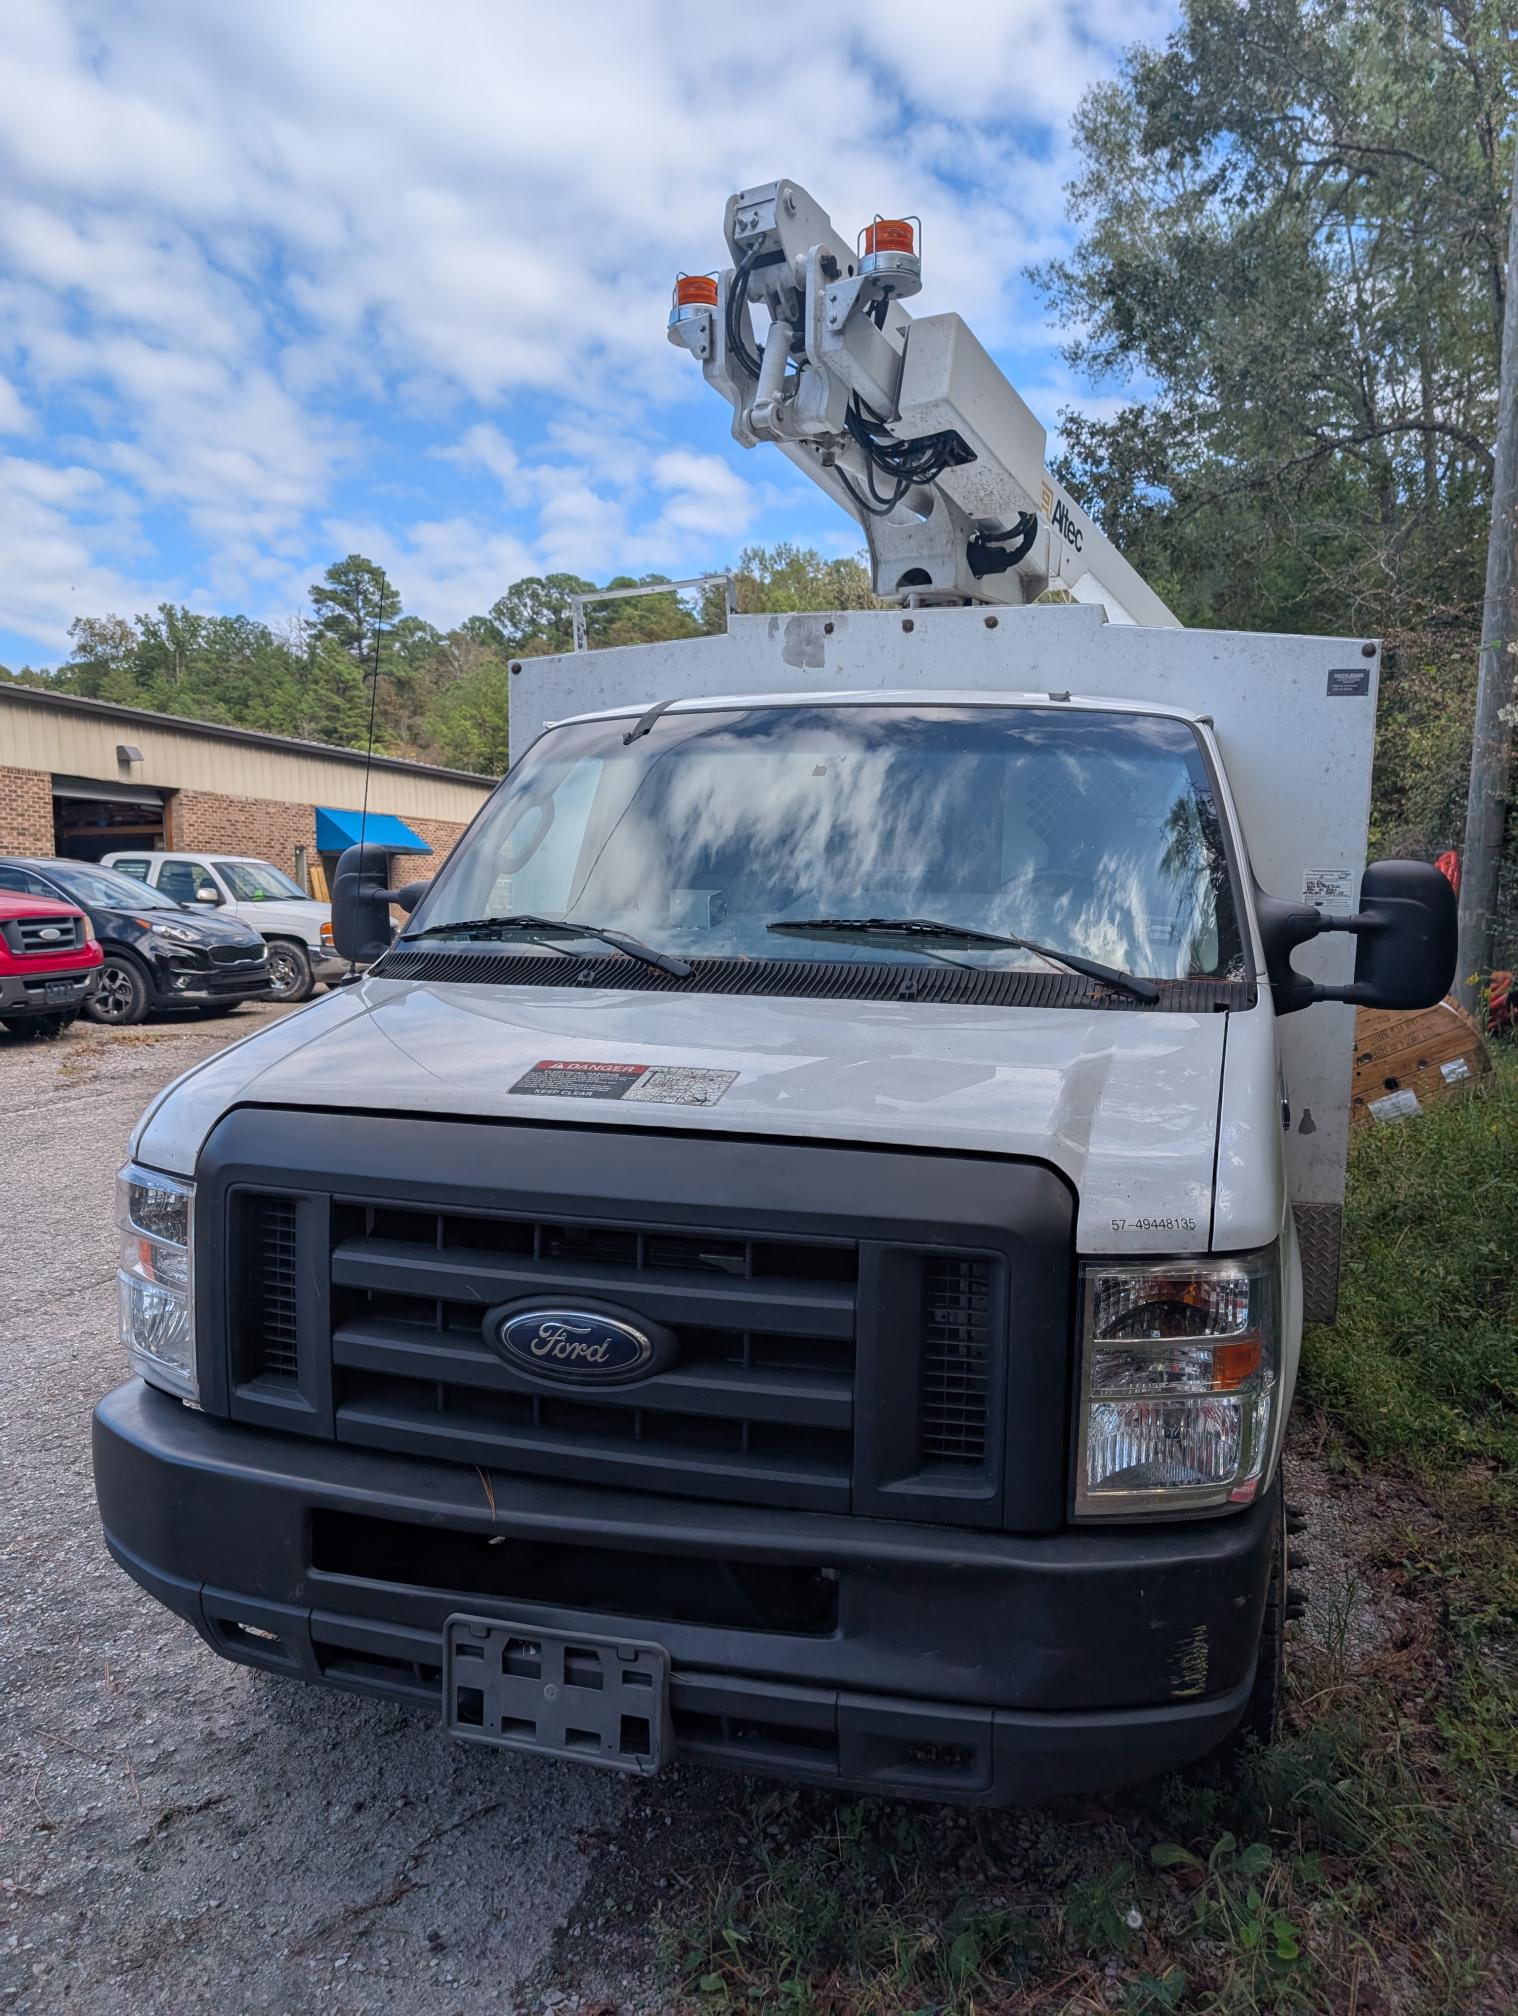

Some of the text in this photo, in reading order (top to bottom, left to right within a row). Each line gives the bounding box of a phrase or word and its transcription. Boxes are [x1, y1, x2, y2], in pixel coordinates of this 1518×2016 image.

[1051, 498, 1083, 552] Altec
[567, 1063, 635, 1073] DANGER
[1111, 1218, 1196, 1231] 57-49448135
[530, 1322, 613, 1363] Ford
